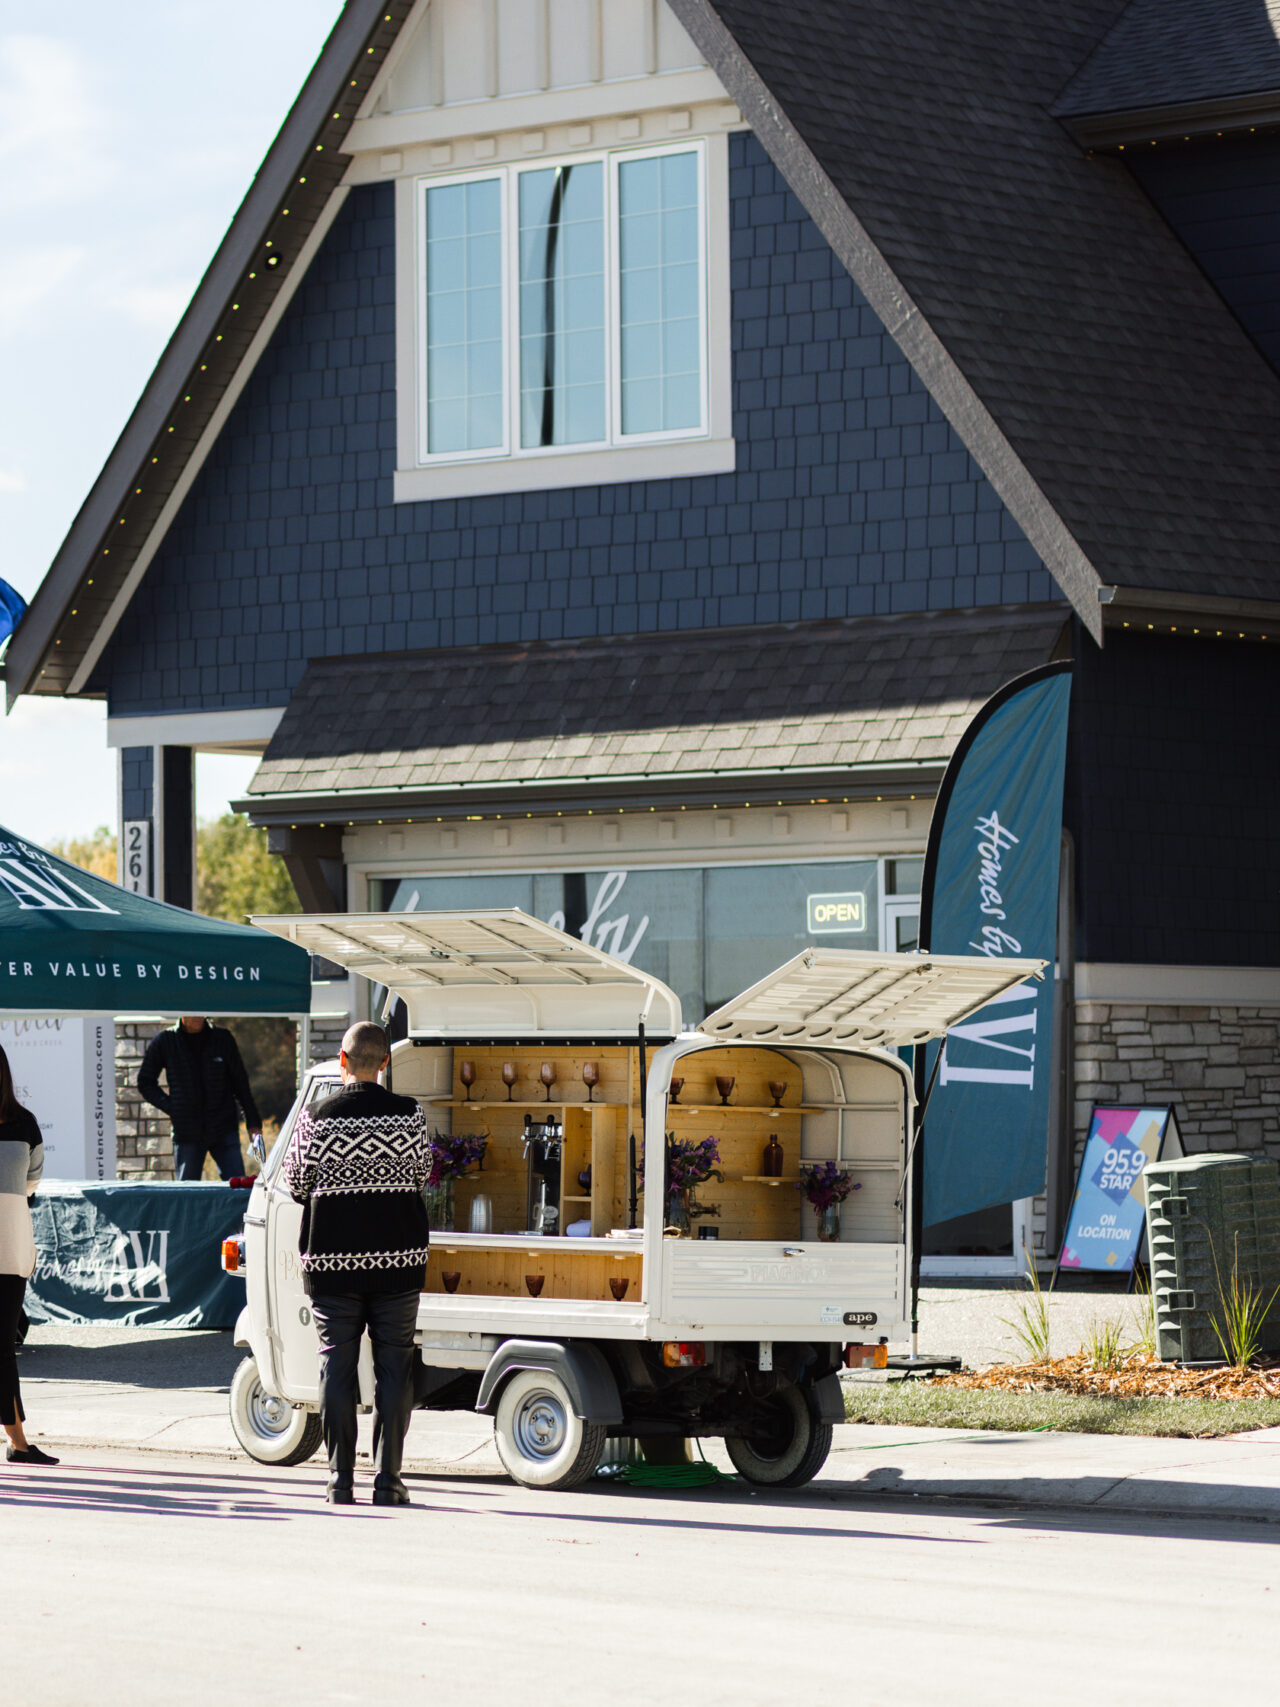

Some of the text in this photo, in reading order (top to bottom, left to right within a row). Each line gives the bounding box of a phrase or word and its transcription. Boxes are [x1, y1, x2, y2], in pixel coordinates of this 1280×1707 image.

[969, 811, 1021, 958] Homes by
[815, 903, 860, 923] OPEN
[49, 962, 121, 977] VALUE
[137, 963, 162, 978] BY
[178, 965, 261, 981] DESIGN
[95, 1025, 105, 1180] erienceSirocco.com
[1101, 1149, 1145, 1175] 95.9
[1100, 1174, 1132, 1190] STAR
[1100, 1214, 1117, 1226] ON
[1078, 1225, 1132, 1241] LOCATION
[848, 1313, 873, 1325] ape
